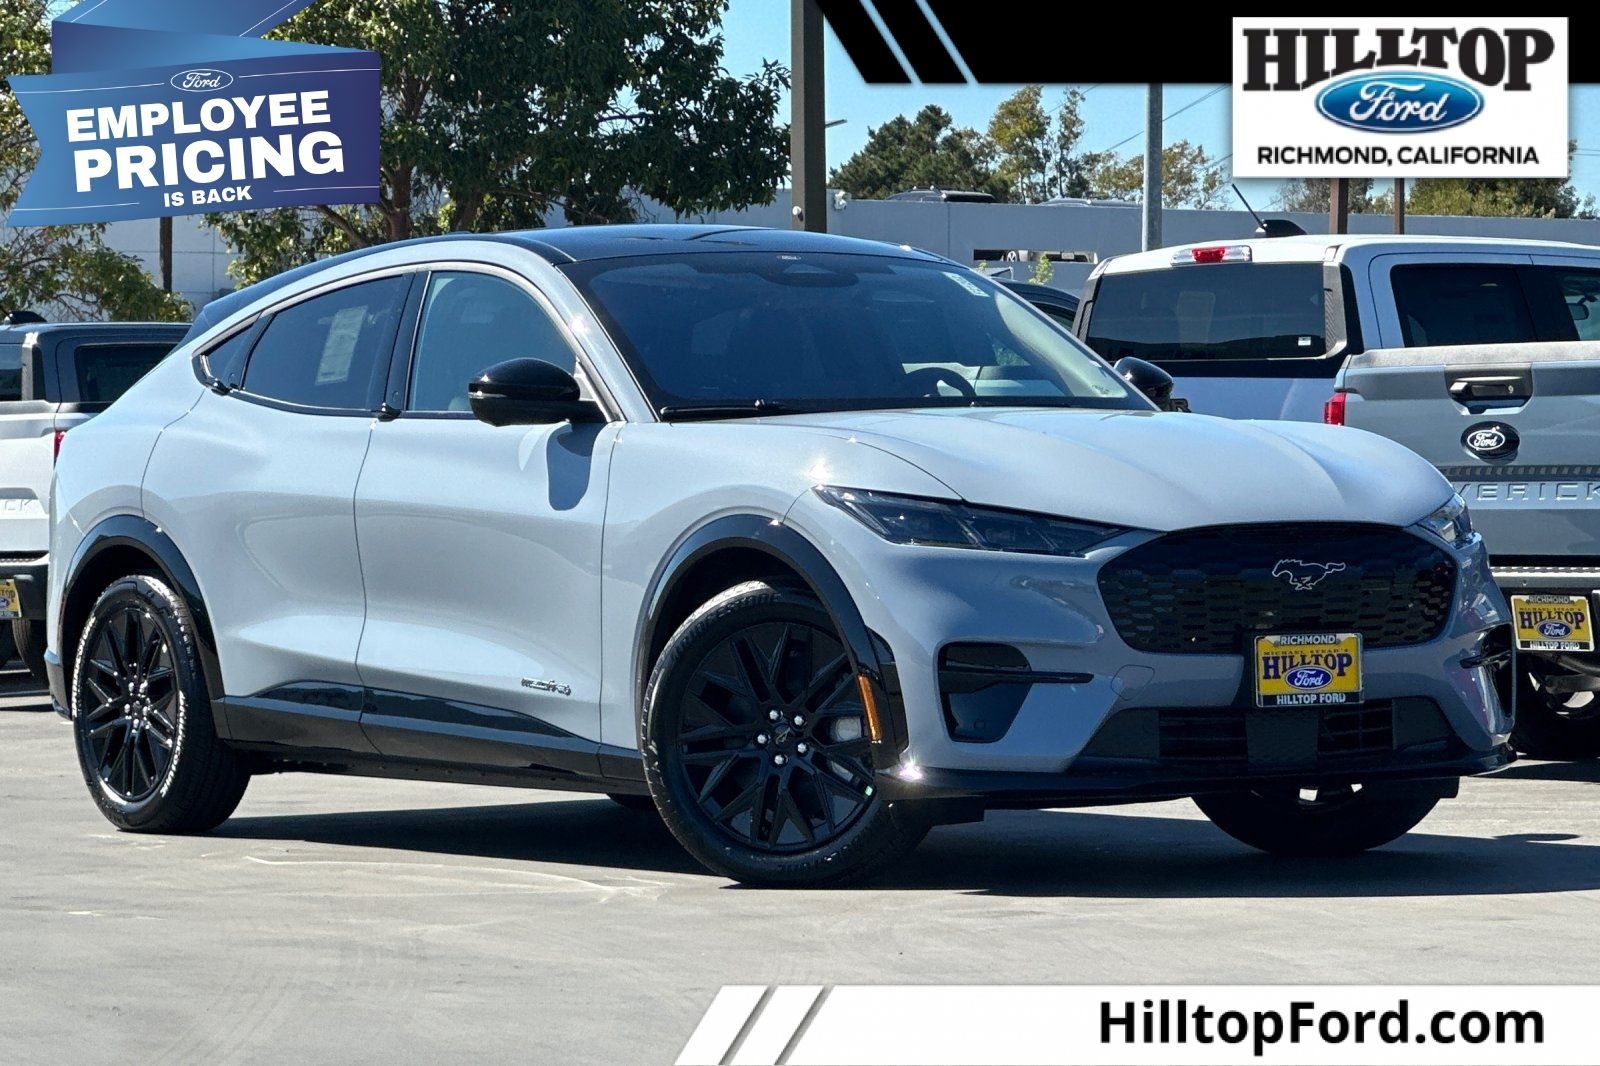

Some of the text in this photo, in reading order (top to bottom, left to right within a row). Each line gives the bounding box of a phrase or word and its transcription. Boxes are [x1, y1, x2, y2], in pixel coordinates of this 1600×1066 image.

[1474, 432, 1498, 447] Ford
[1529, 595, 1570, 604] RICHMOND
[1519, 611, 1585, 630] HILLTOP
[1544, 623, 1566, 636] Ford
[1281, 635, 1336, 646] RICHMOND
[1530, 640, 1580, 650] HILLTOP FORD
[1262, 653, 1353, 680] HILLTOP
[1294, 669, 1324, 687] Ford
[1276, 693, 1346, 705] HILLTOP FORD
